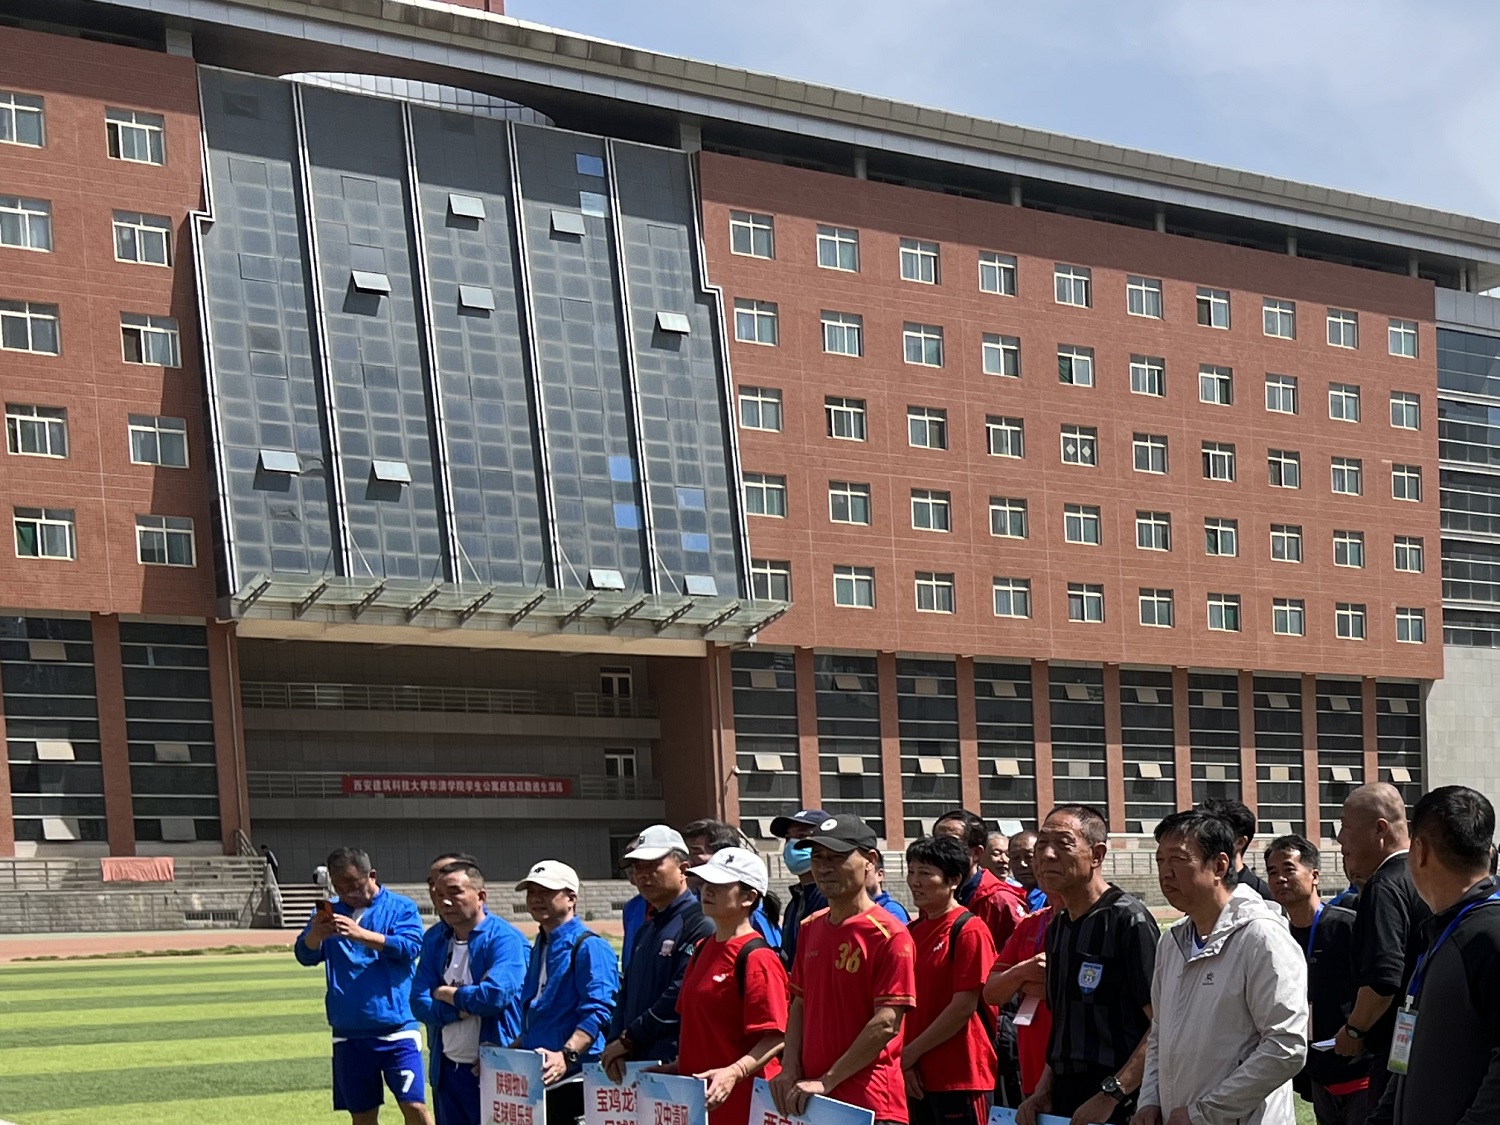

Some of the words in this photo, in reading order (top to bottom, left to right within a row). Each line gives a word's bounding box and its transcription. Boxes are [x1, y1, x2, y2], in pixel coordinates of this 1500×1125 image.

[835, 943, 861, 973] 36
[400, 1069, 415, 1093] 7
[596, 1087, 638, 1113] 宝鸡龙
